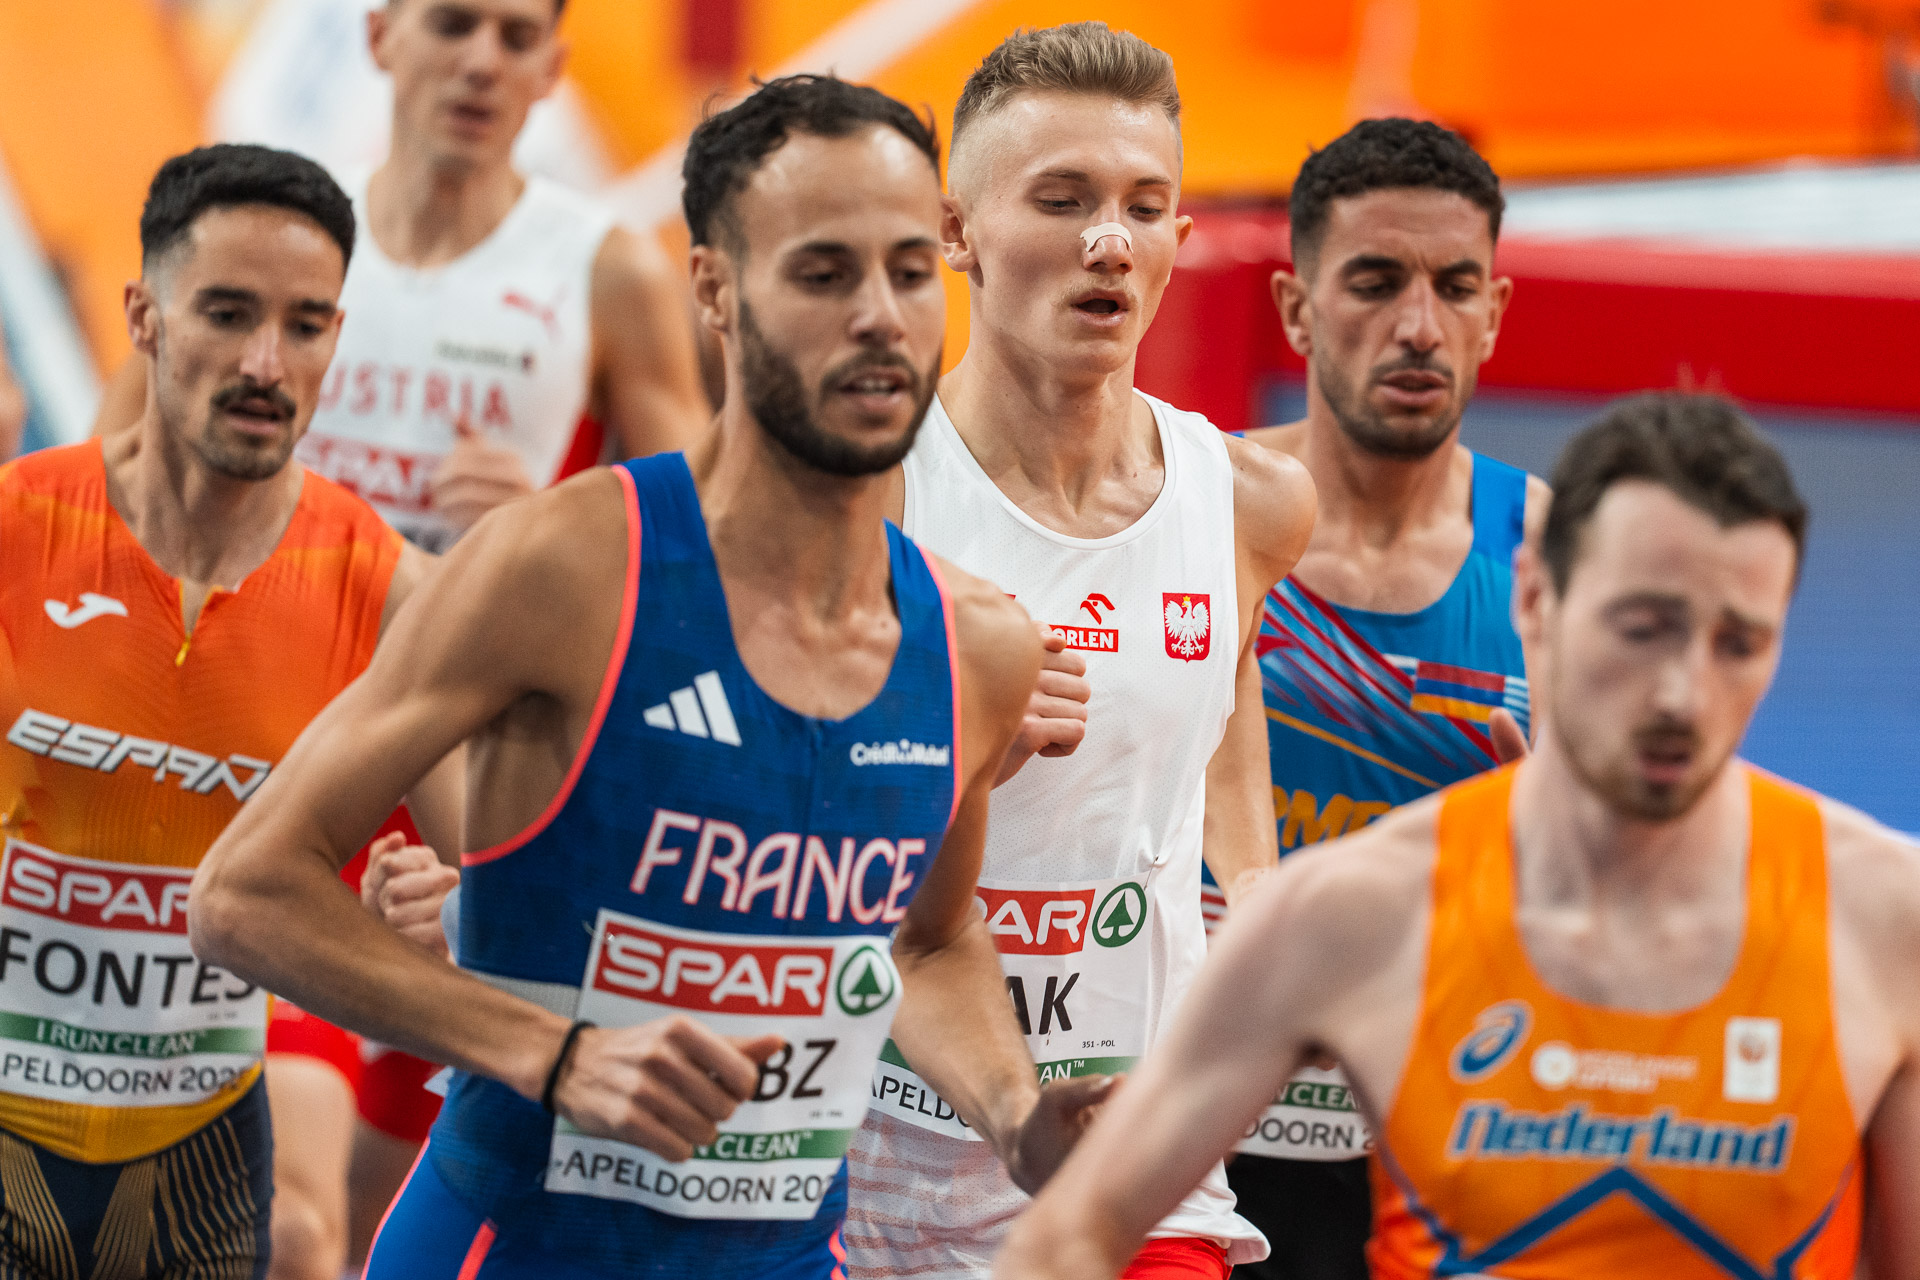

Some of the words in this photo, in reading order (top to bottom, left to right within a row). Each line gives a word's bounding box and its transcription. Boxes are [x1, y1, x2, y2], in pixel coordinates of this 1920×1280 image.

[629, 808, 926, 925] FRANCE
[976, 899, 1087, 946] AR
[602, 933, 826, 1007] SPAR
[50, 1023, 110, 1050] RUN
[1082, 1040, 1095, 1048] 351
[871, 1075, 972, 1128] PELD
